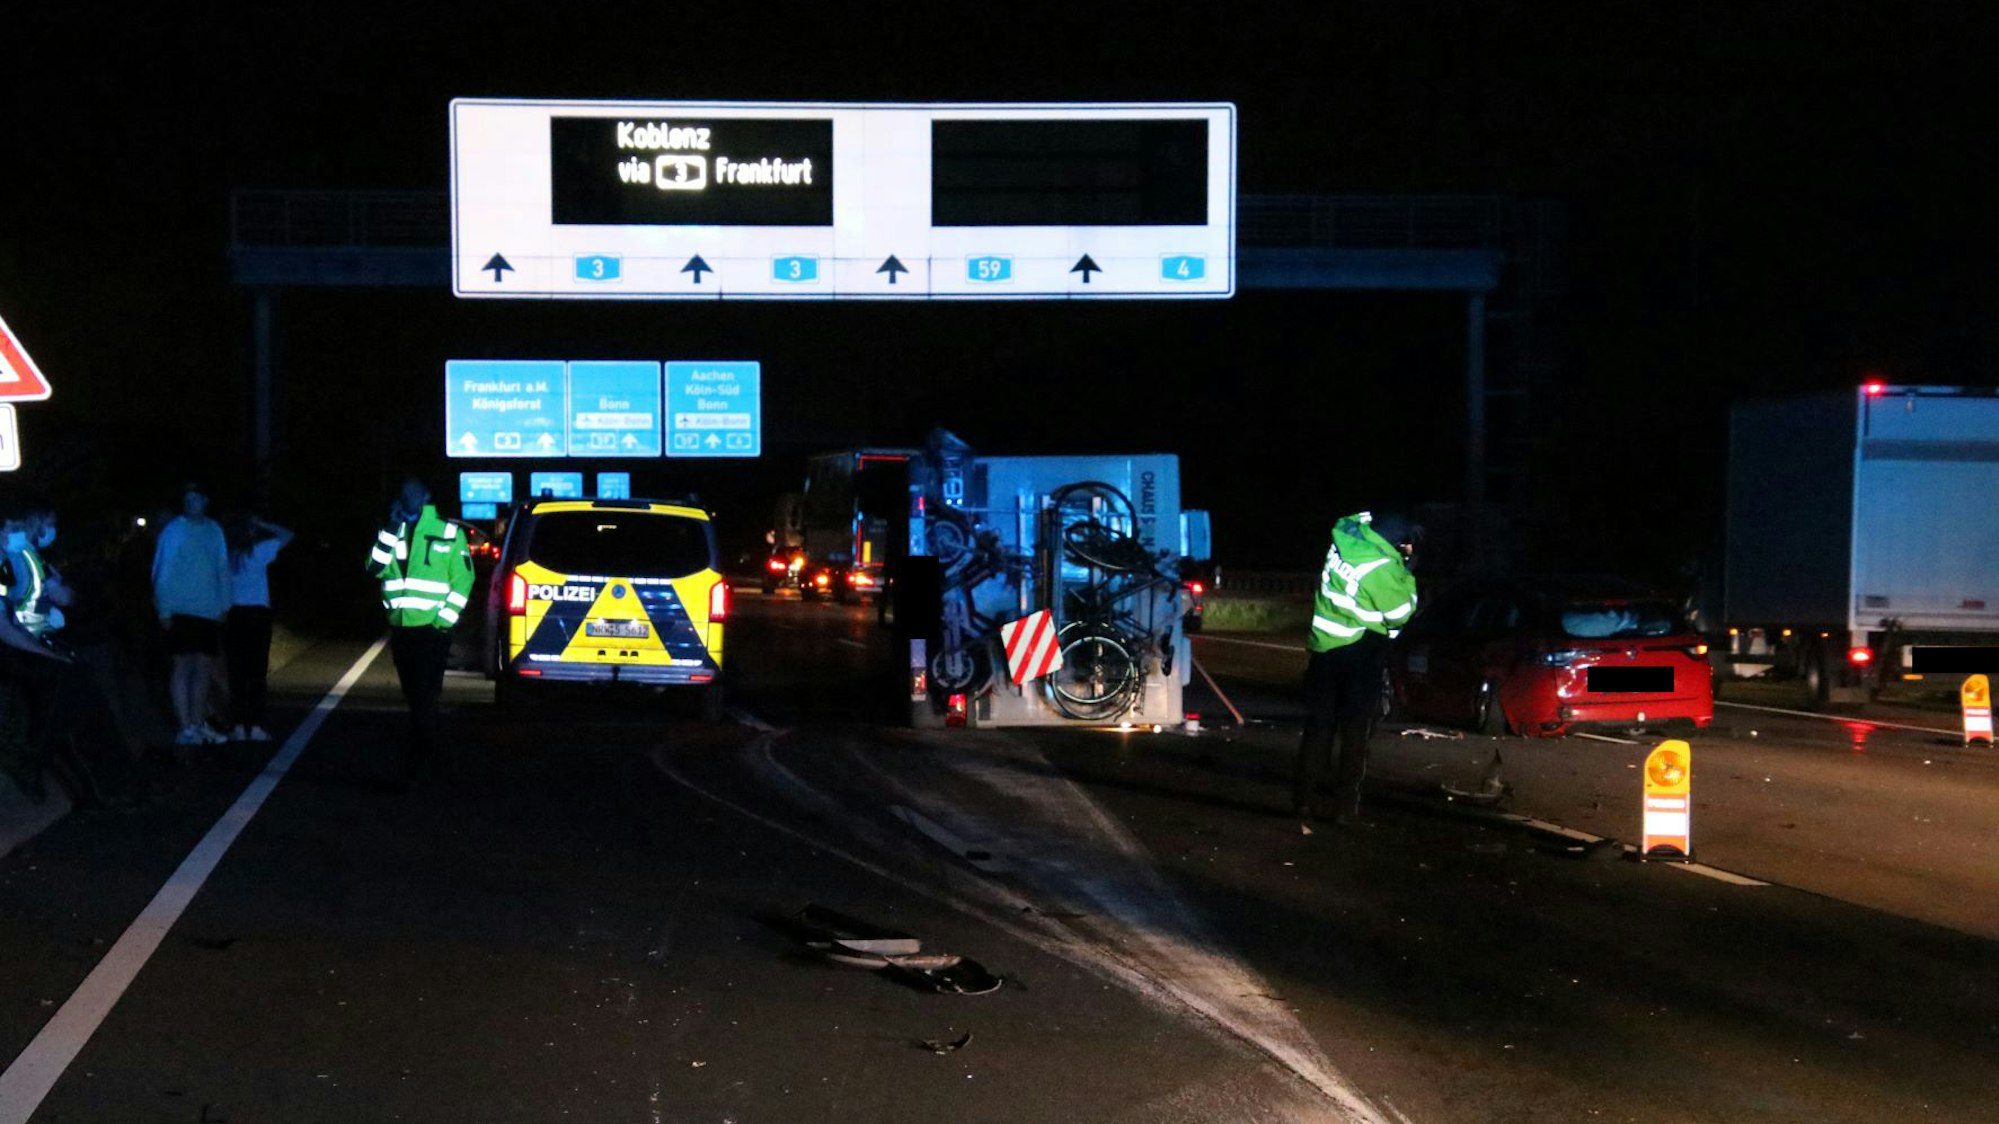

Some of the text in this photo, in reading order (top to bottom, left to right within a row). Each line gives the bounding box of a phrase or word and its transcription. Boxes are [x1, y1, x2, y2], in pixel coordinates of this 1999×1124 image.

[616, 122, 711, 150] Koblenz
[618, 157, 651, 184] via
[715, 157, 813, 185] Frankfurt
[591, 259, 605, 278] 3
[789, 260, 802, 279] 3
[977, 260, 1001, 279] 59
[1176, 259, 1190, 278] 4
[691, 370, 735, 382] Aachen
[463, 380, 521, 393] Frankfurt
[472, 397, 541, 413] Königsforst
[599, 397, 630, 411] Bonn
[697, 397, 728, 411] Bonn
[528, 585, 596, 602] POLIZEI
